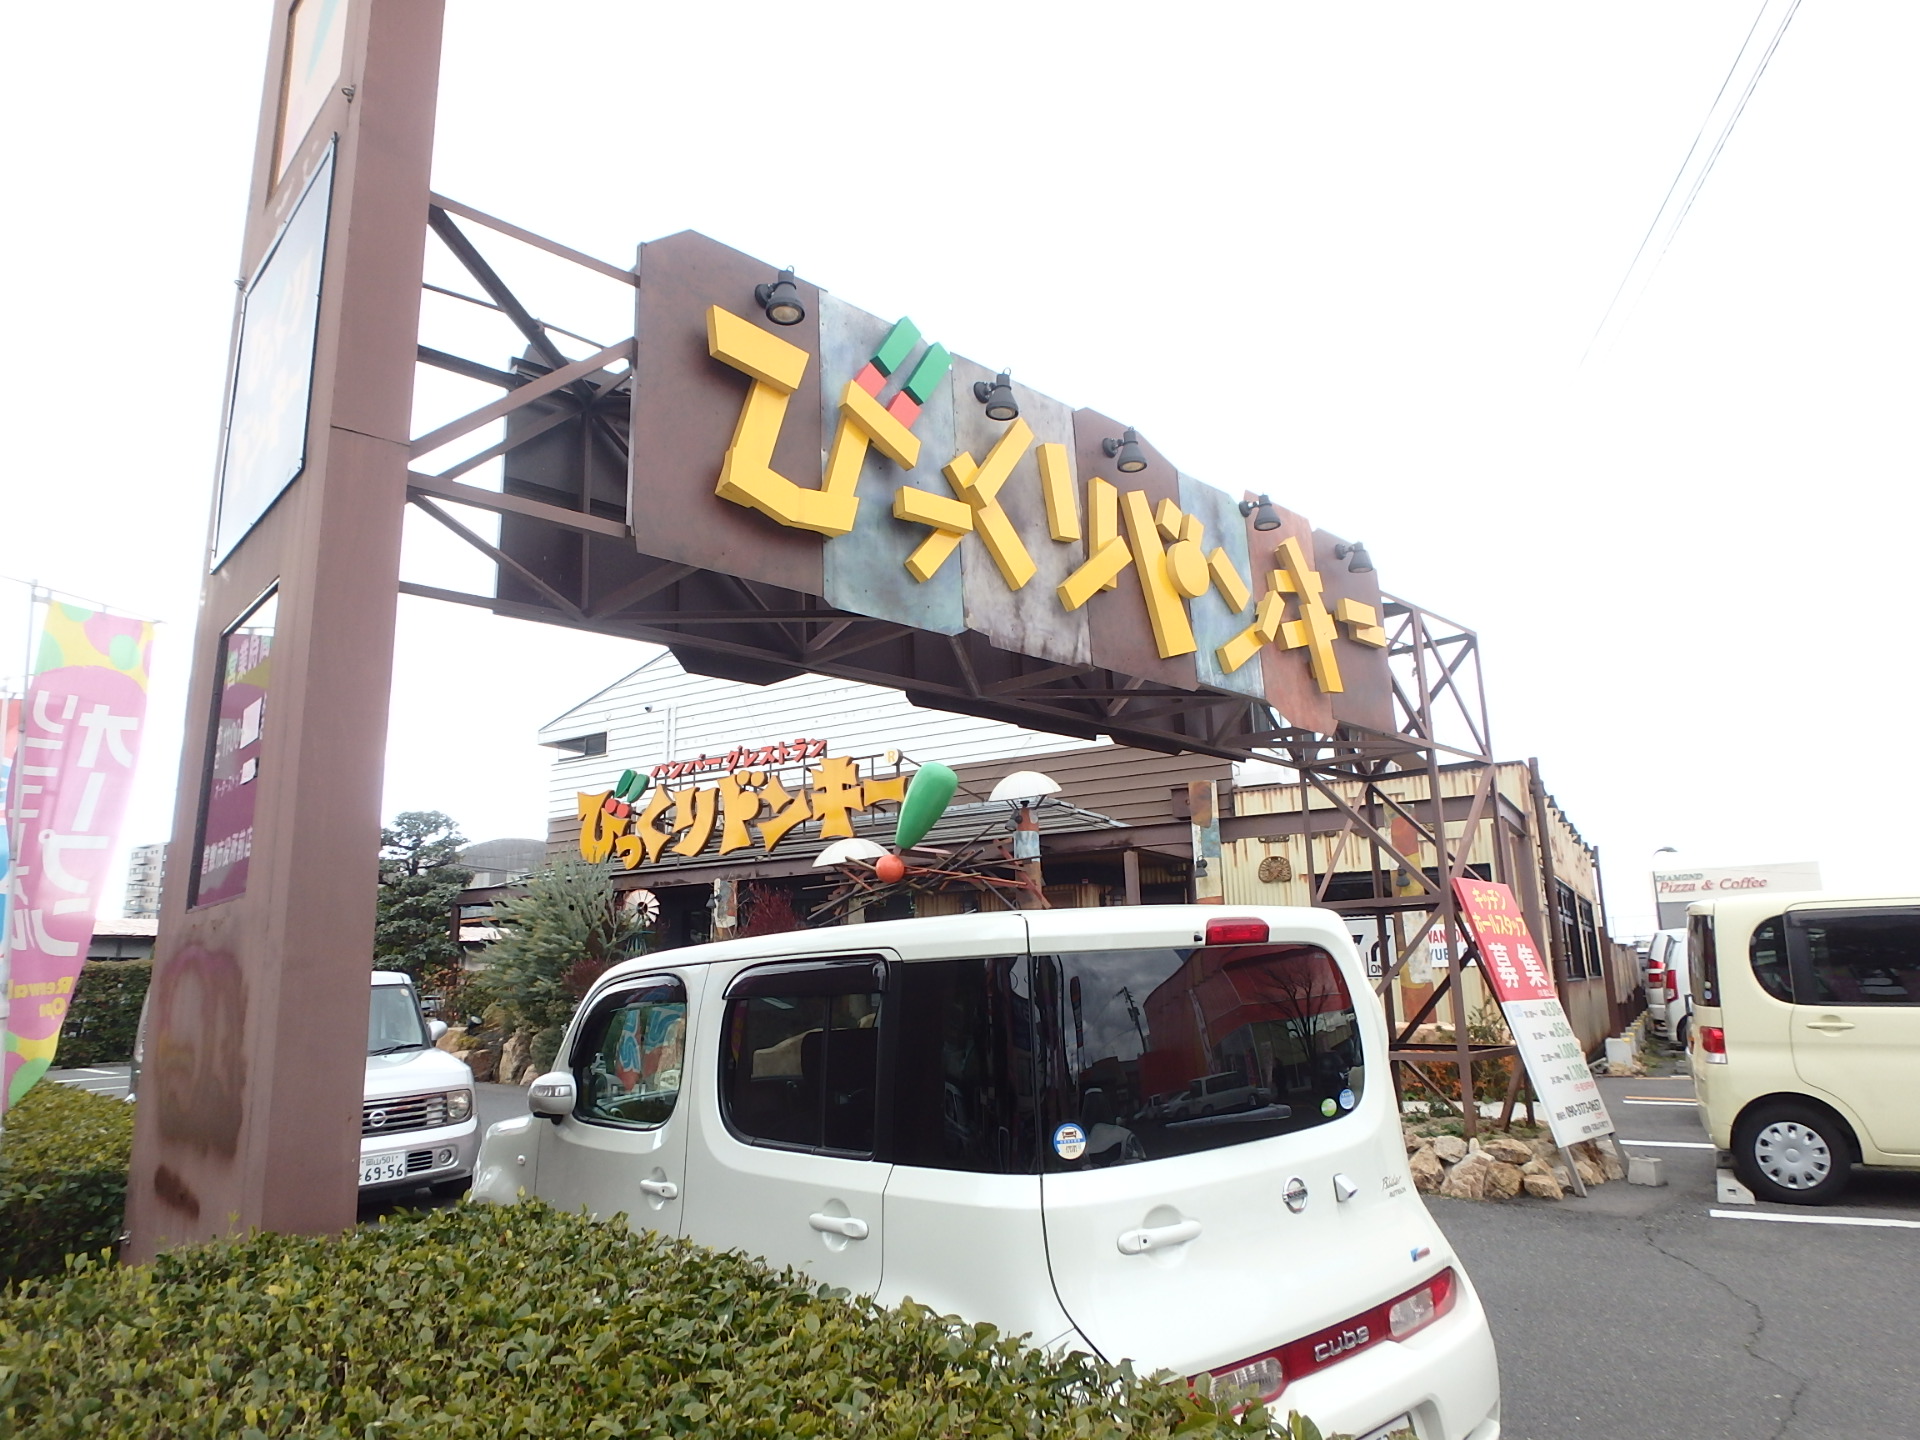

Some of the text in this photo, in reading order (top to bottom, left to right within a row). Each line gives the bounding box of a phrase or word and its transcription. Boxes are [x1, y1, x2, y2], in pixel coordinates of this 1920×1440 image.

[651, 738, 827, 779] ハンバーグレストラン
[1659, 876, 1767, 893] Pizza & Coffee
[1472, 888, 1506, 911] キッチン
[1473, 912, 1527, 937] ホールスタッフ
[364, 1163, 403, 1182] 69-56
[1314, 1325, 1370, 1362] cube
